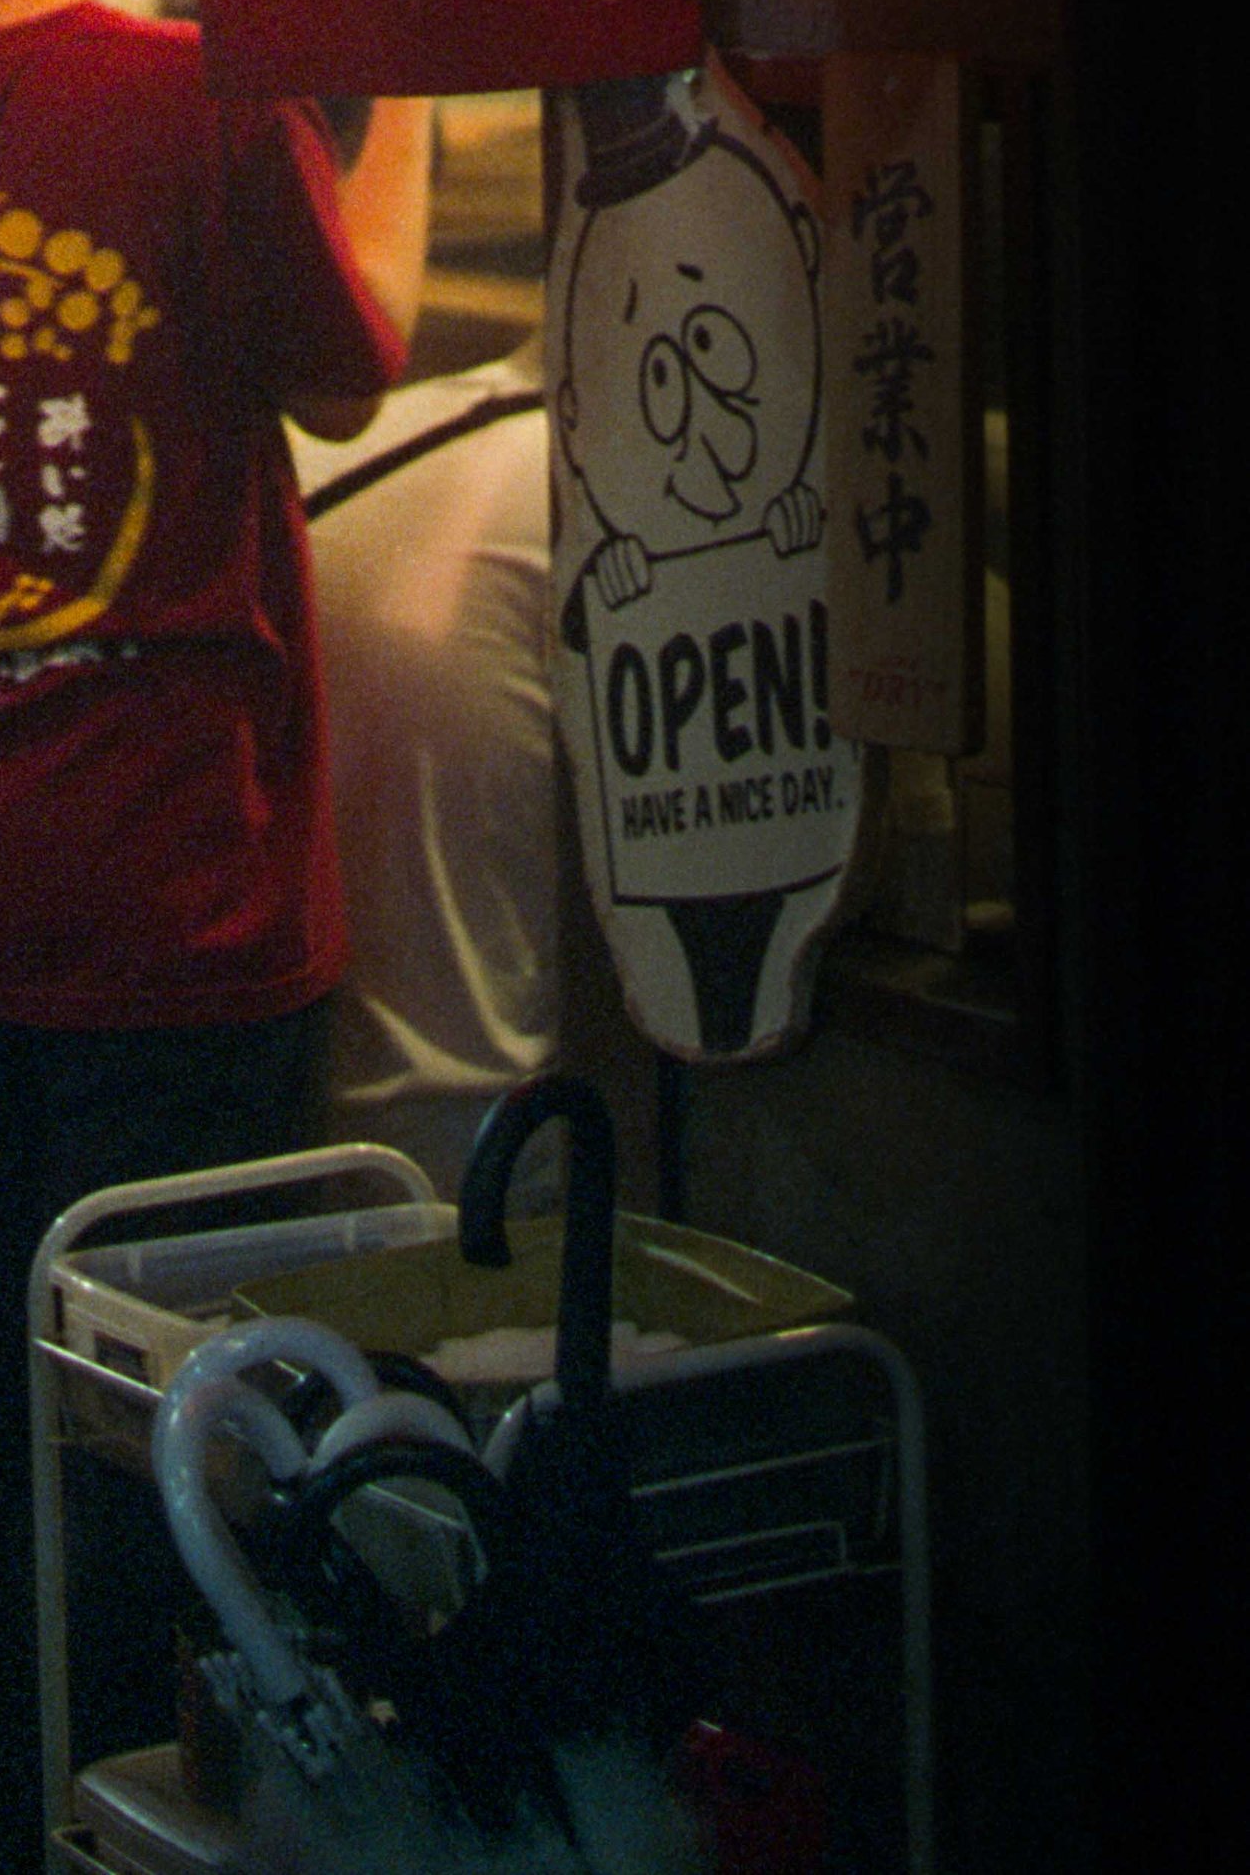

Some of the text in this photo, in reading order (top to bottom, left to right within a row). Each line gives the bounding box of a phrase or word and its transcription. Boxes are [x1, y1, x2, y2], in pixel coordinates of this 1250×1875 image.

[850, 160, 936, 607] 営業中
[607, 598, 831, 777] OPEN!
[621, 765, 845, 839] HAVE A NICE DAY.
